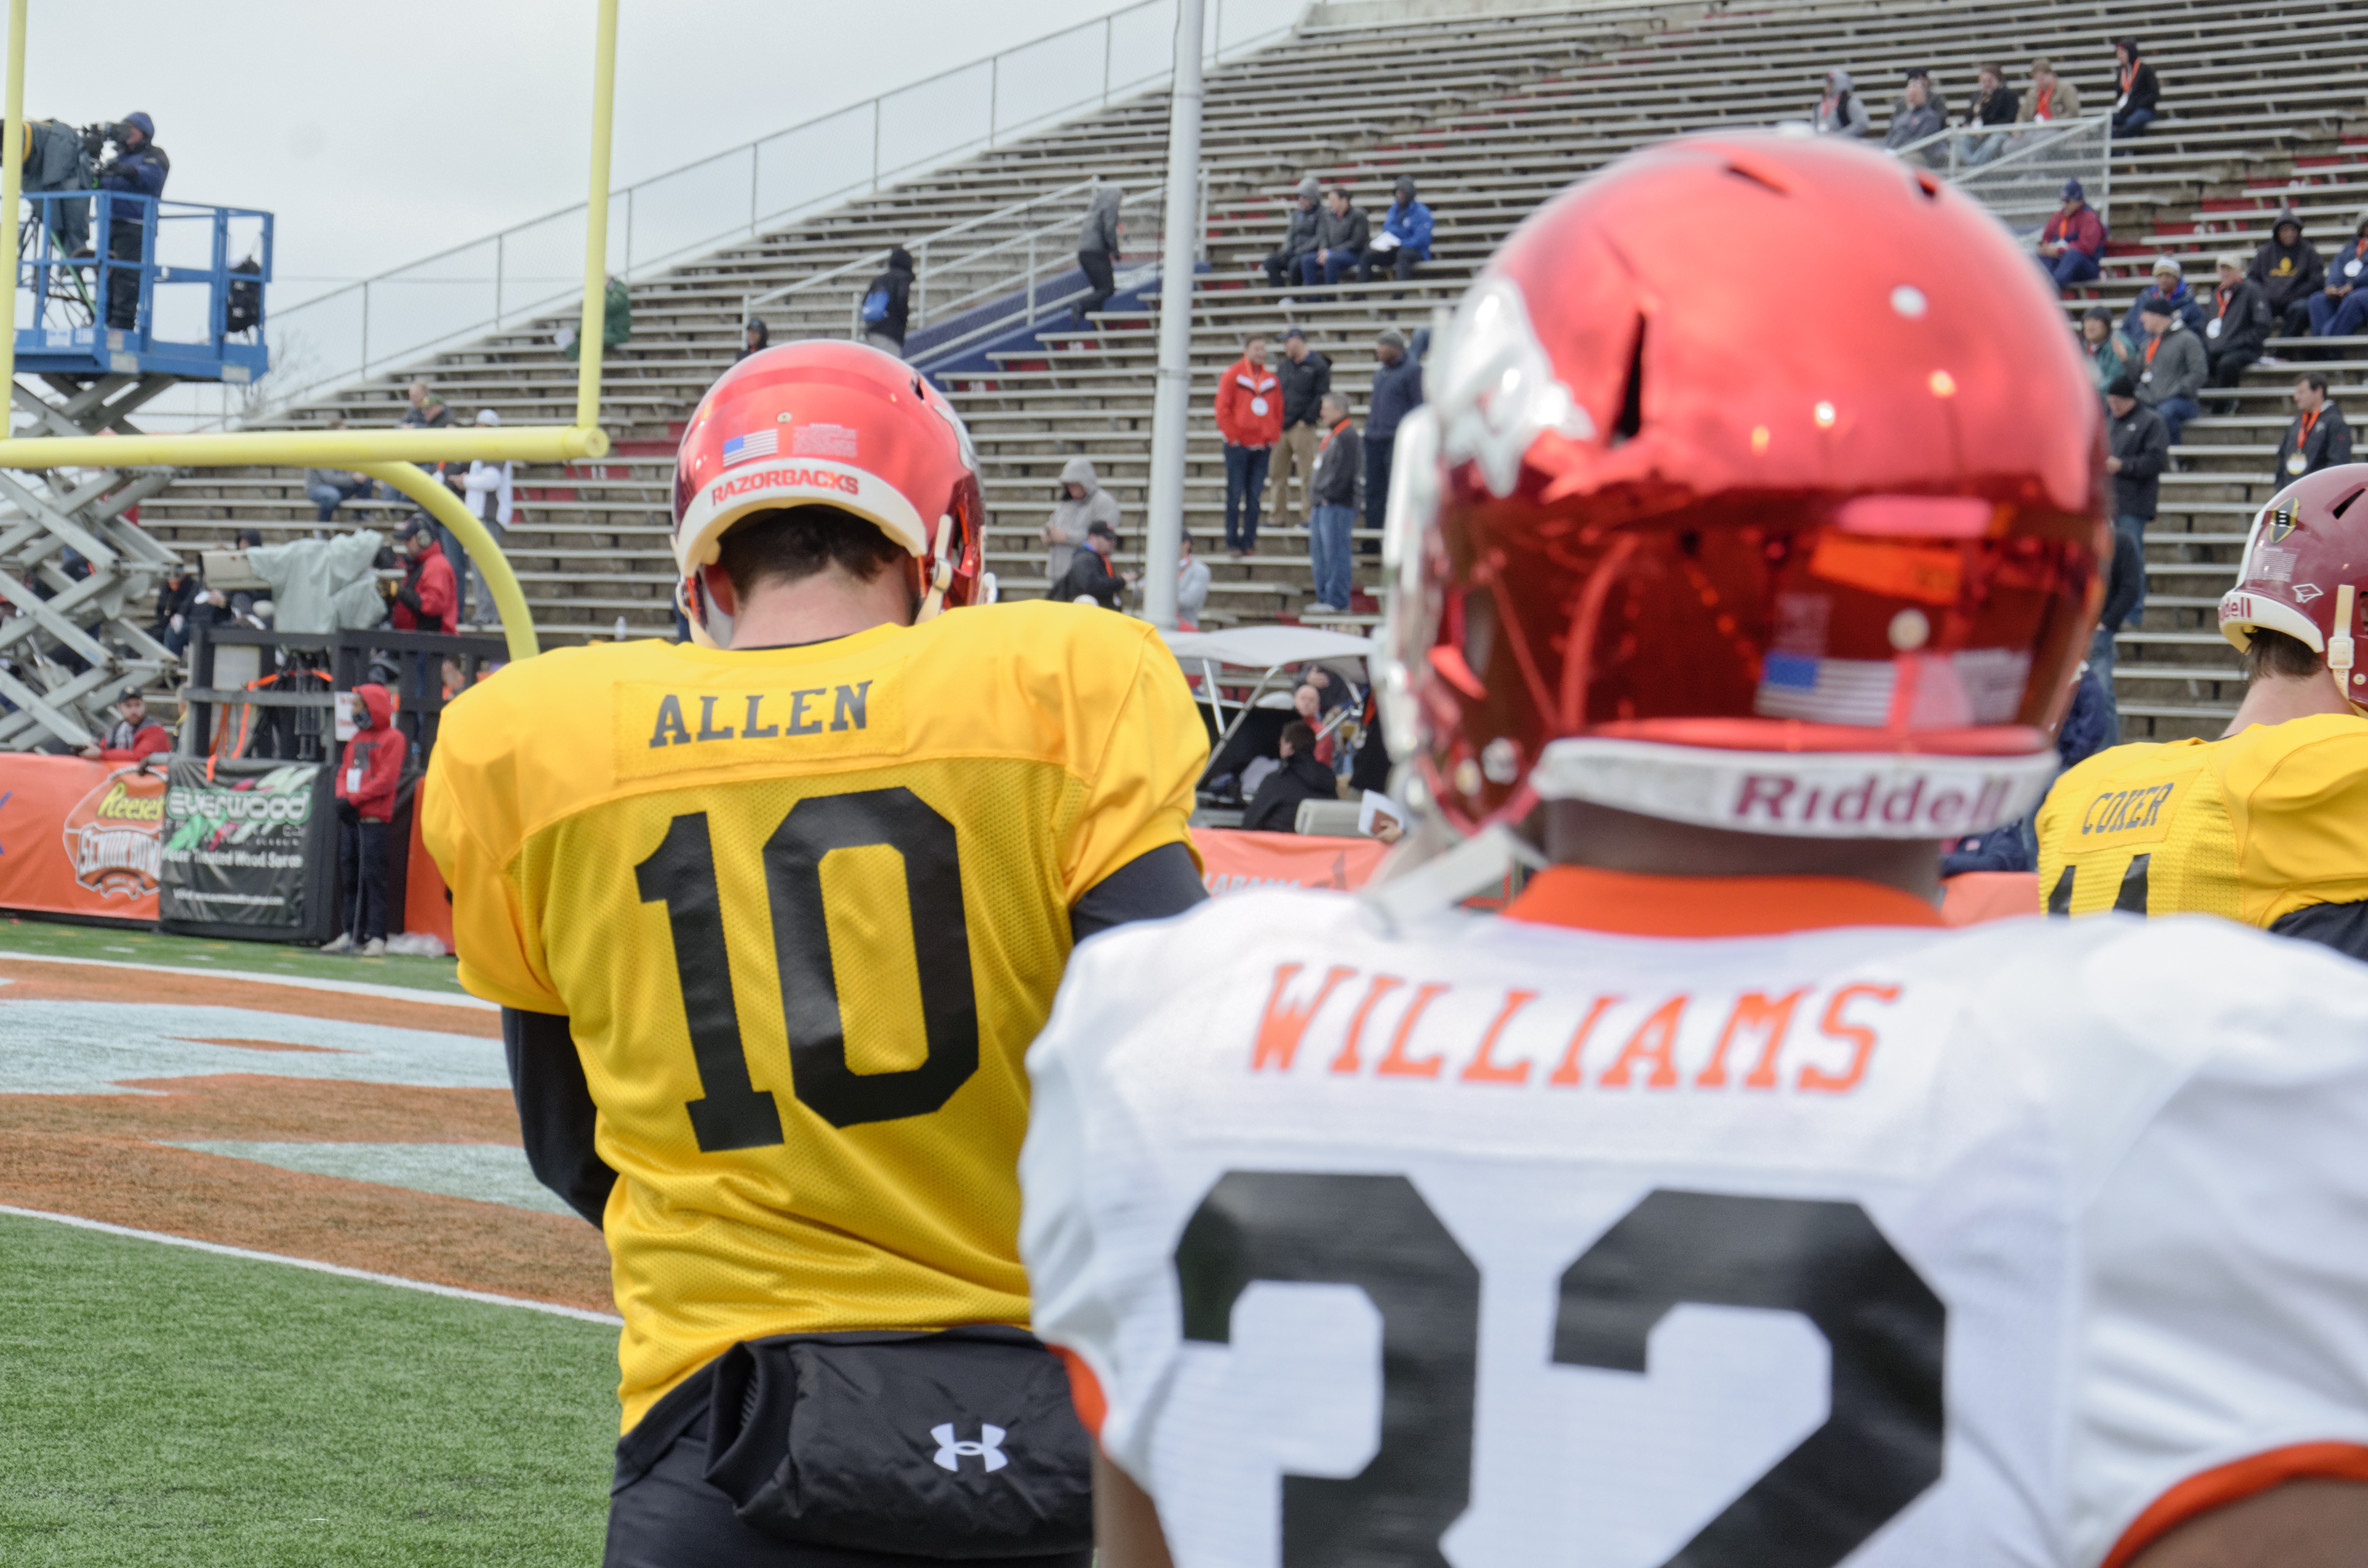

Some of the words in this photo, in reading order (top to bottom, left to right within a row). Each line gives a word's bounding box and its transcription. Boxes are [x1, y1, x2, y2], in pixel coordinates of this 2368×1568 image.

[712, 469, 859, 507] RAZORBACKS
[649, 680, 873, 748] ALLEN
[1734, 773, 2013, 833] Riddell
[2081, 783, 2174, 835] COKER
[634, 785, 979, 1152] 10
[1250, 963, 1902, 1093] WILLIAMS
[1174, 1169, 1948, 1568] 32
